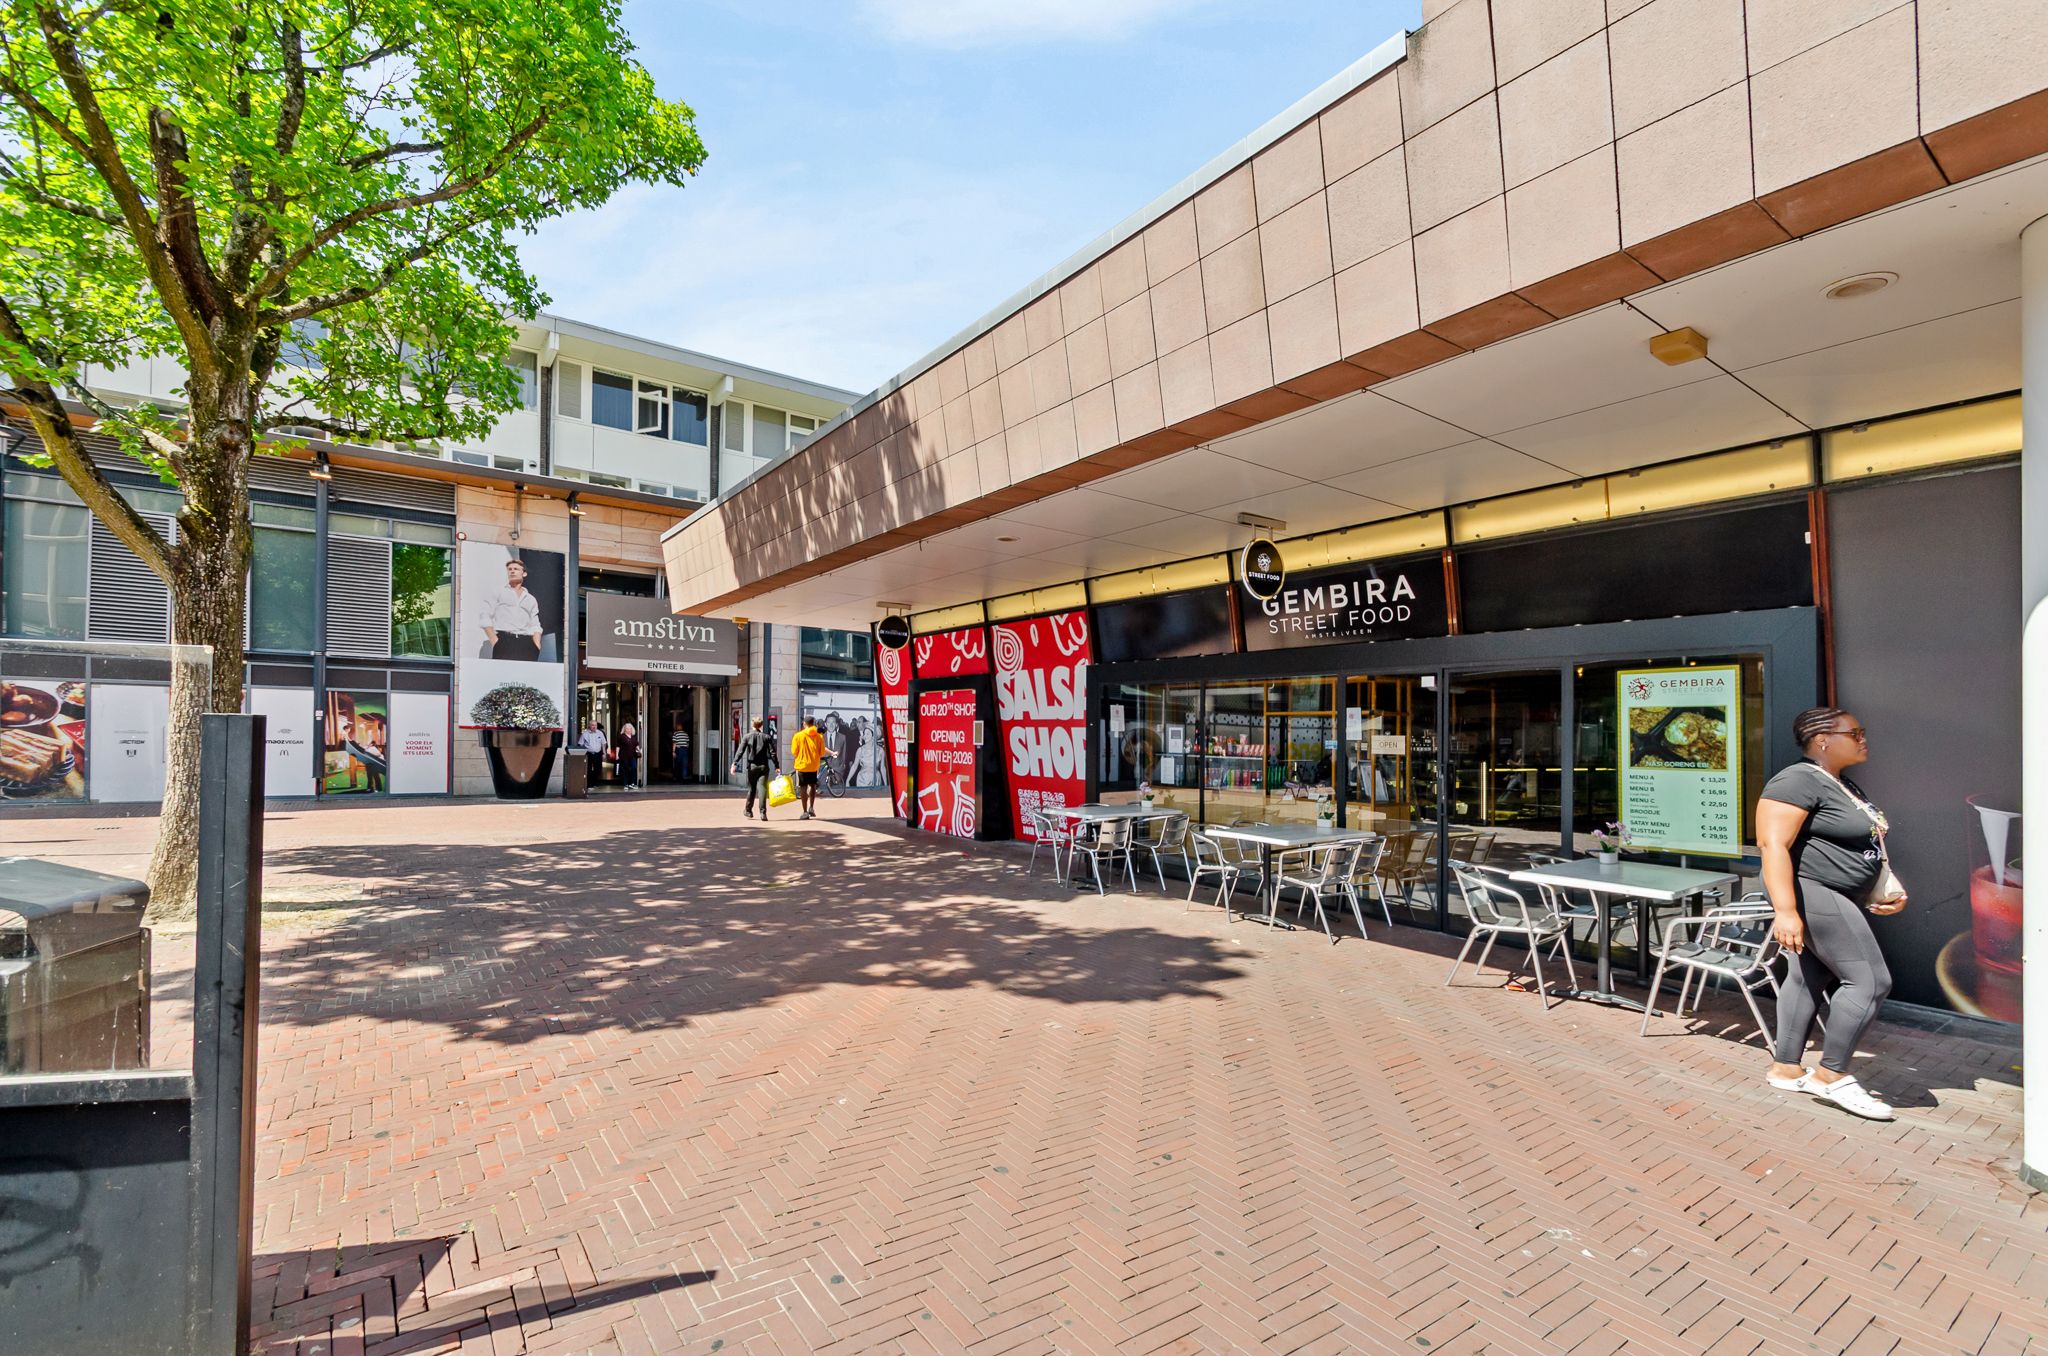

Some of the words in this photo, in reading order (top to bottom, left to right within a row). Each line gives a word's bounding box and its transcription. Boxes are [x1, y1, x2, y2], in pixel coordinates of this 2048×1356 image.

[1262, 574, 1416, 616] GEMBIRA
[1269, 613, 1339, 634] STREET
[1349, 605, 1411, 626] FOOD
[614, 617, 716, 643] amstlvn
[648, 662, 678, 670] ENTREE
[1660, 678, 1725, 688] GEMBIRA
[920, 704, 937, 716] OUR
[931, 730, 965, 743] OPENING
[923, 749, 952, 763] WINTER
[953, 751, 973, 765] 2026
